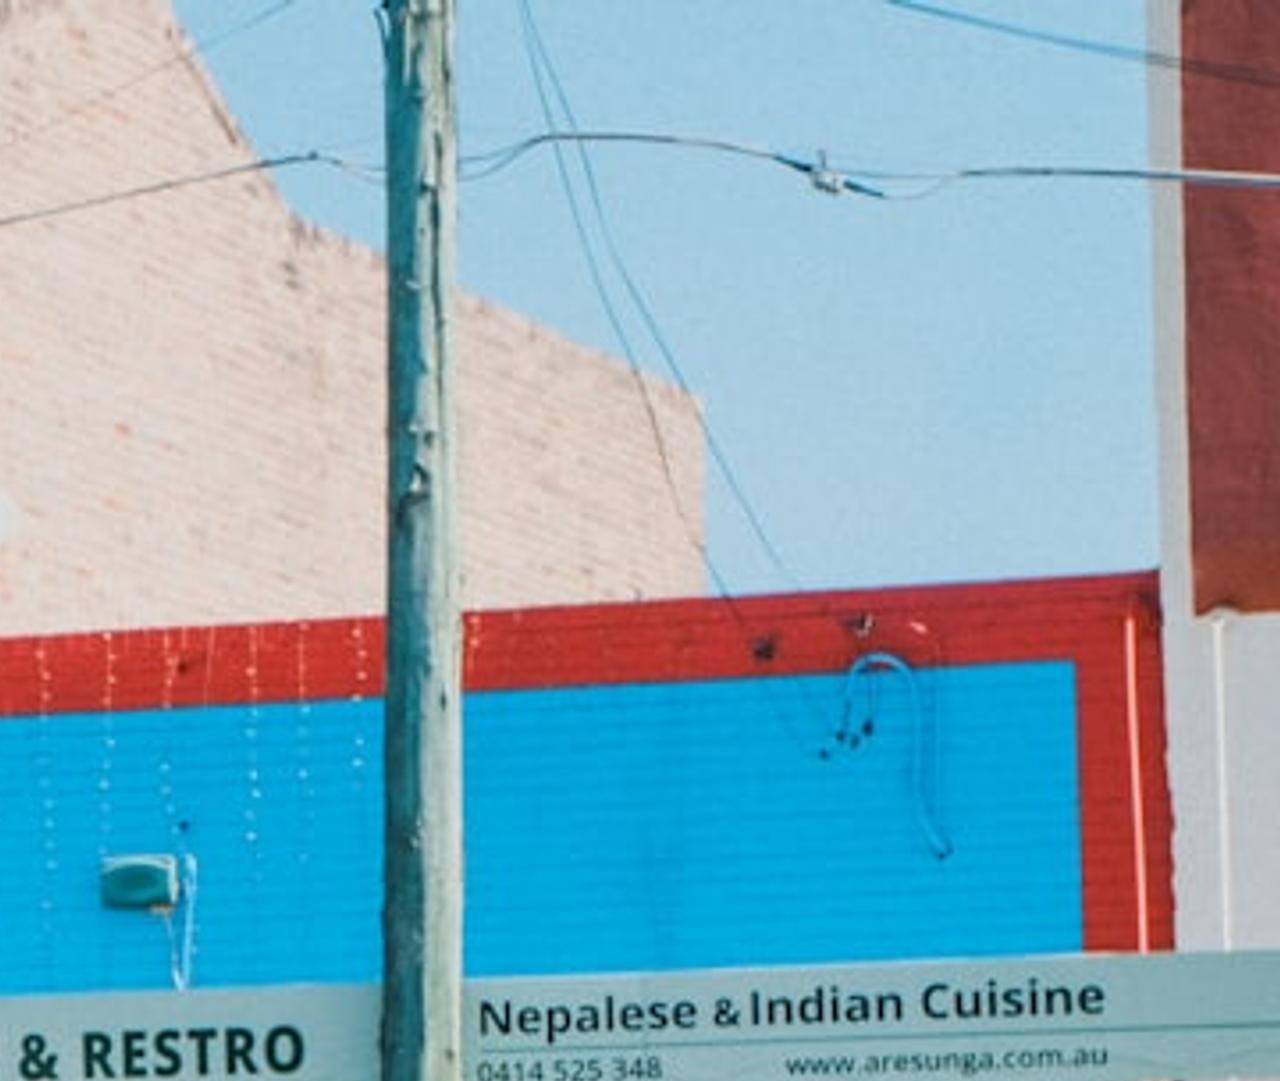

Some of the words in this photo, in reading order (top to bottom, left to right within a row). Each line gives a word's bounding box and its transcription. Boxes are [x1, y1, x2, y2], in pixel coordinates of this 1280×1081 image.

[478, 993, 699, 1044] Nepalese
[713, 997, 741, 1027] &
[750, 980, 904, 1026] Indian
[921, 976, 1107, 1022] Cuisine
[19, 1034, 59, 1081] &
[82, 1024, 307, 1079] RESTRO
[612, 1055, 664, 1081] 348
[784, 1044, 1111, 1077] www.aresunga.com.au
